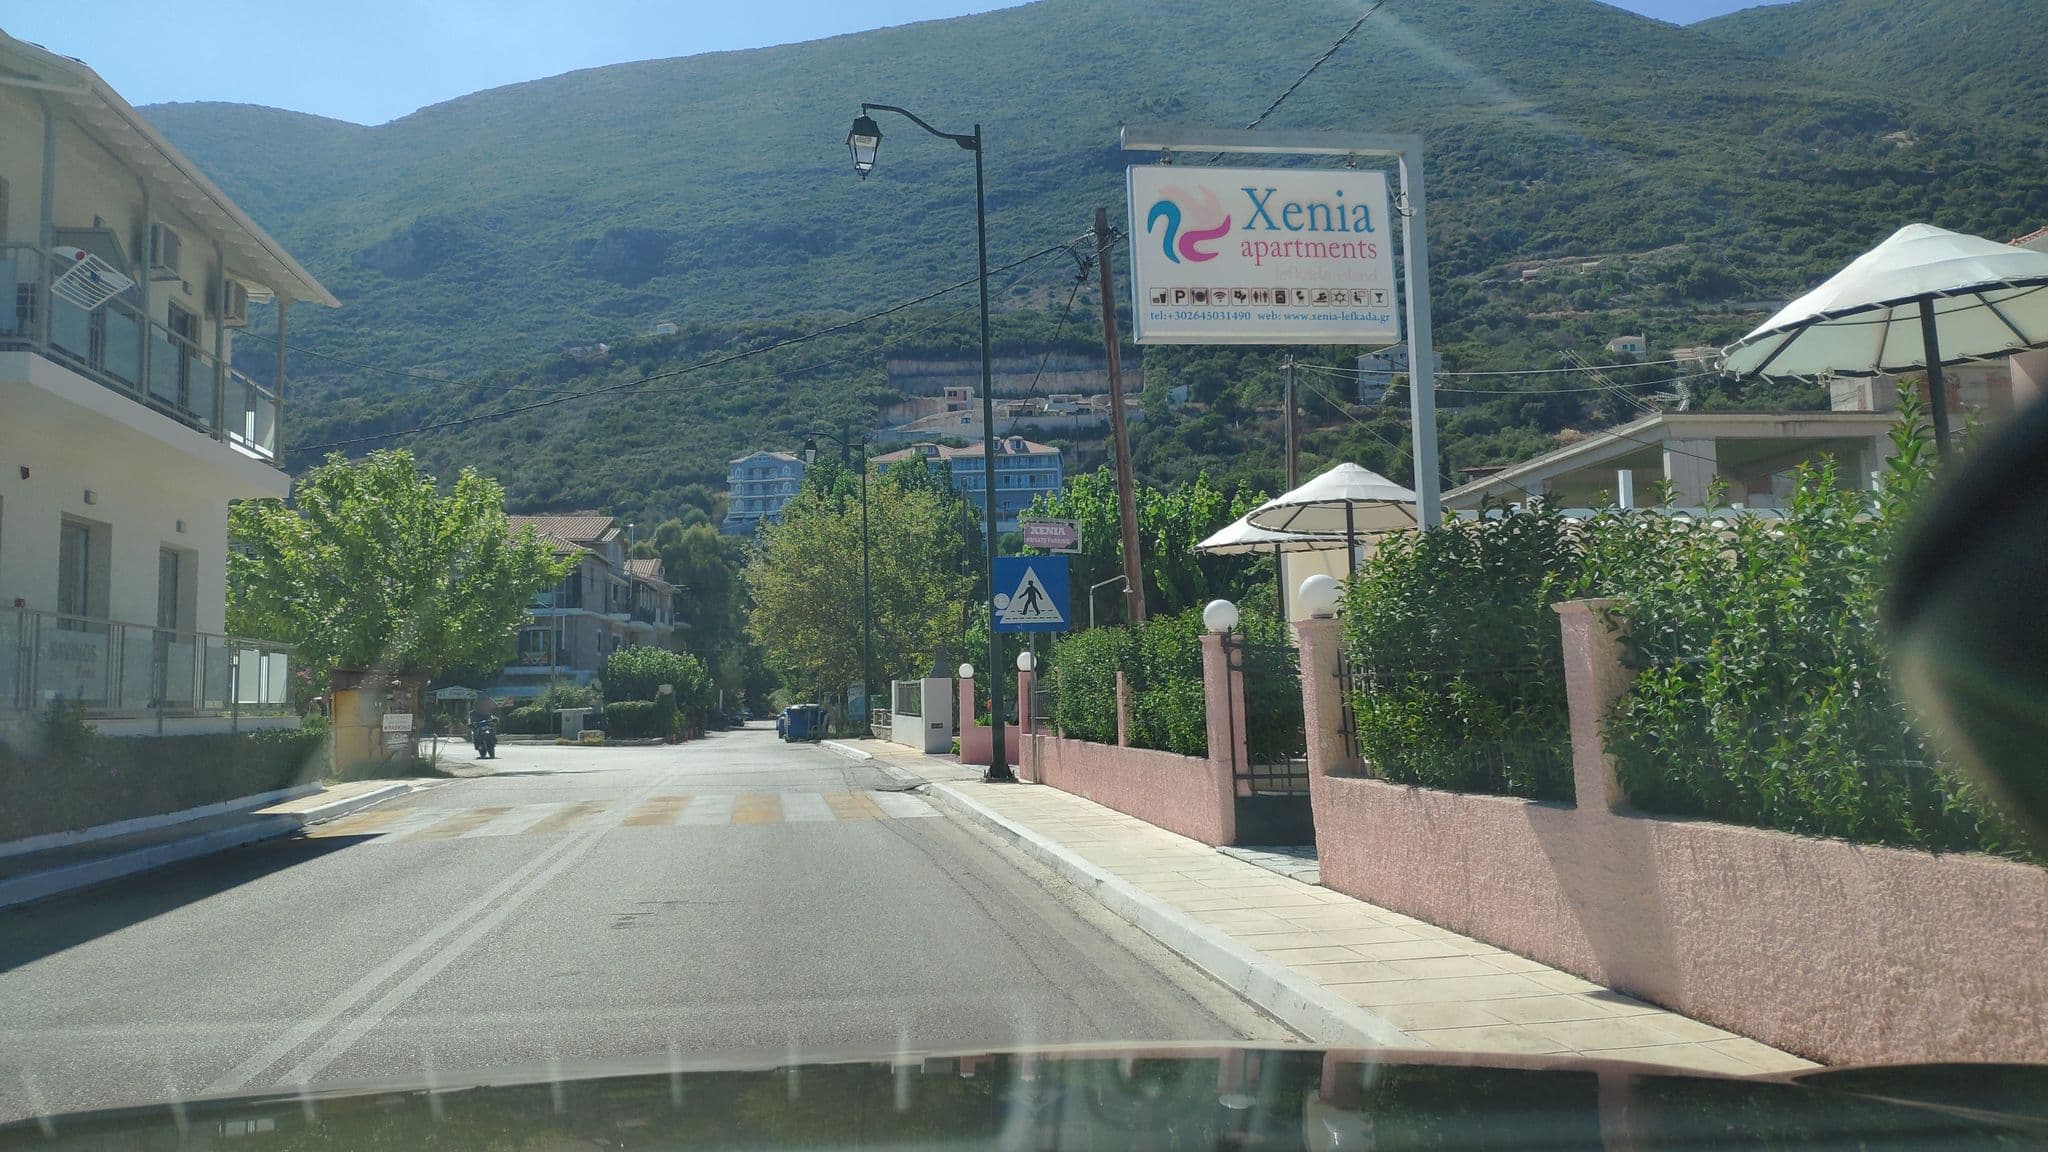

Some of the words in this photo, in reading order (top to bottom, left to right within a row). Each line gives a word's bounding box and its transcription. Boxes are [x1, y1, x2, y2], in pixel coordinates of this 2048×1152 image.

[1241, 186, 1375, 233] Xenia
[1240, 239, 1378, 266] apartments
[1257, 310, 1282, 321] web:
[1284, 311, 1391, 324] www.xenia-lefkada.gr
[1030, 526, 1066, 535] XENIA
